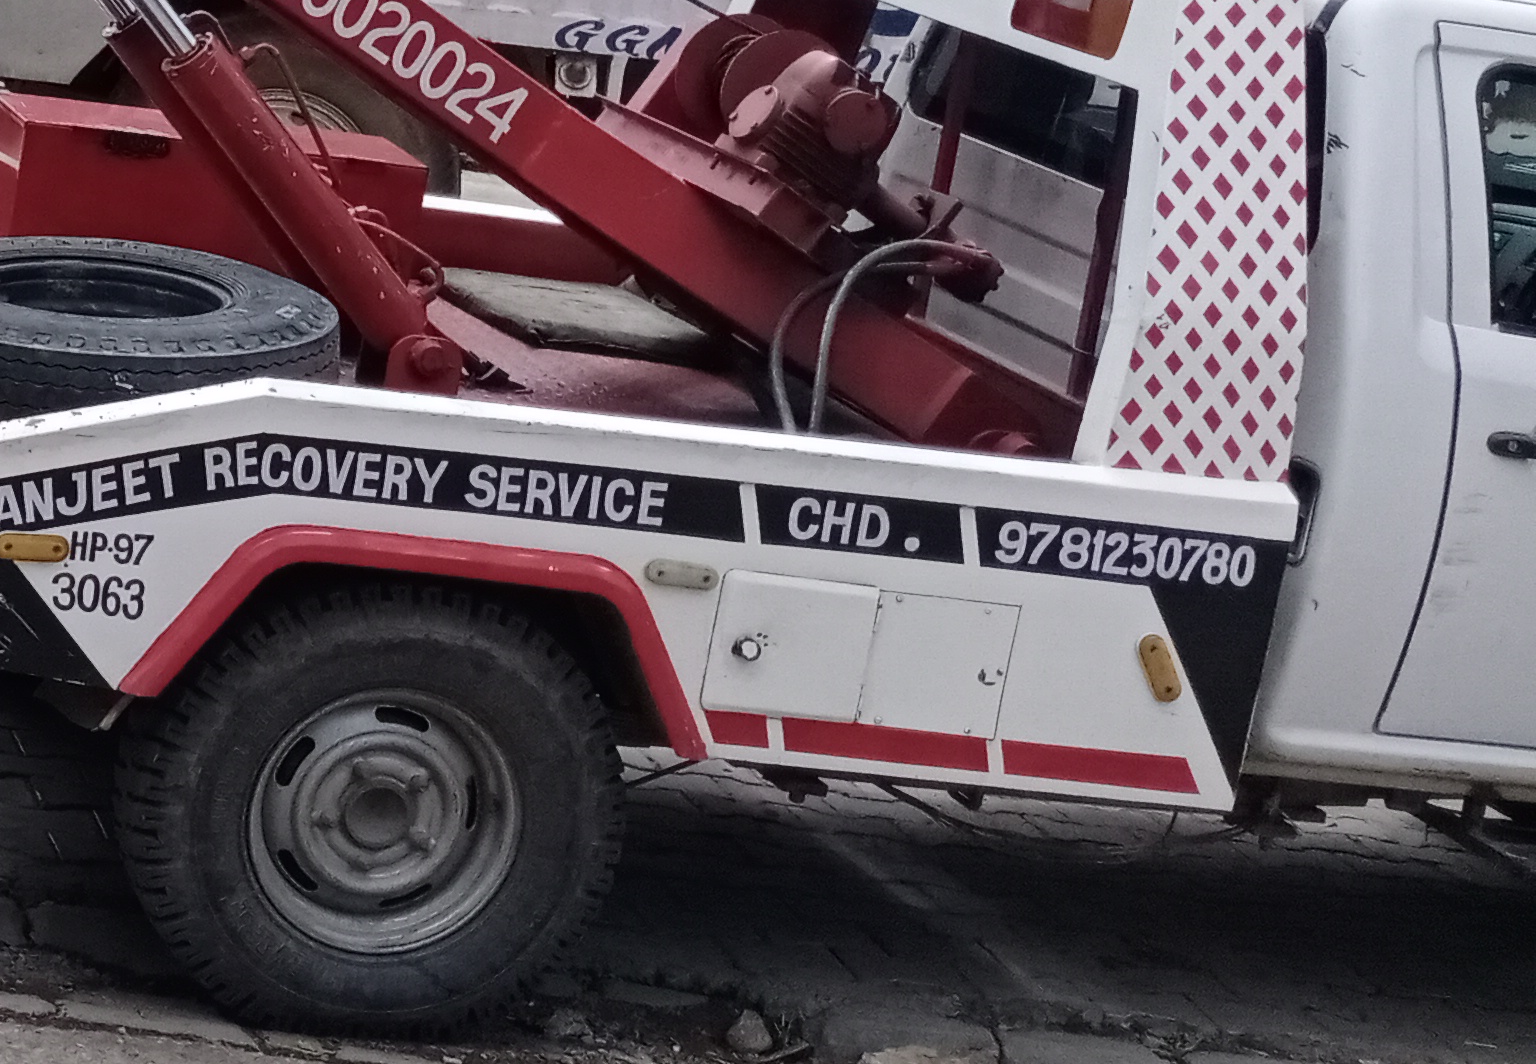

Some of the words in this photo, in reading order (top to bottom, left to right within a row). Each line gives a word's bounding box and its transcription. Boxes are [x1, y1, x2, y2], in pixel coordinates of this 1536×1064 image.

[205, 440, 449, 504] RECOVERY
[465, 464, 669, 527] SERVICE
[994, 521, 1257, 588] 9781230780
[52, 572, 145, 620] 3063
